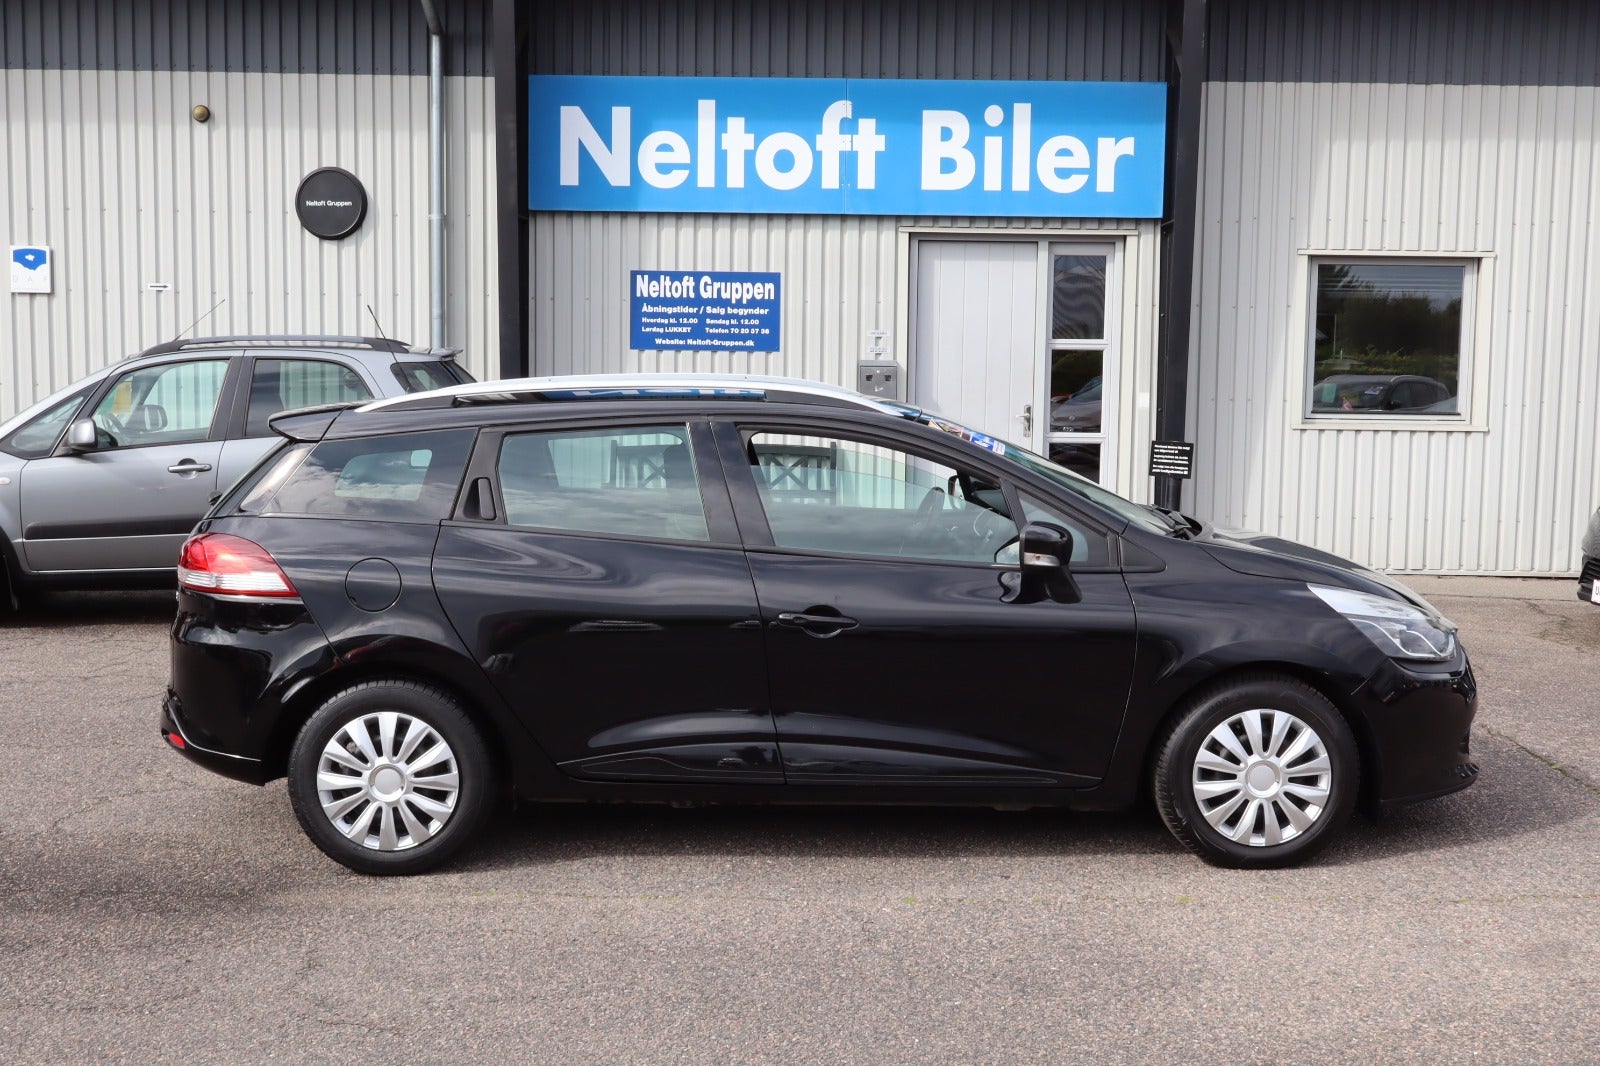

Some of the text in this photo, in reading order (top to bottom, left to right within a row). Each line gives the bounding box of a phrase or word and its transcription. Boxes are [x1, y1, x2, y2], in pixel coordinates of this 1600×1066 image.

[559, 99, 1135, 194] Neltoft Biler
[326, 200, 353, 208] Gruppen
[636, 274, 775, 304] Neltoft Gruppen
[641, 302, 698, 314] Åbningstider
[705, 306, 726, 316] Salg
[727, 306, 770, 316] begynder
[679, 317, 698, 325] 12.00
[654, 338, 755, 348] Website: Neltoft-Gruppen.dk
